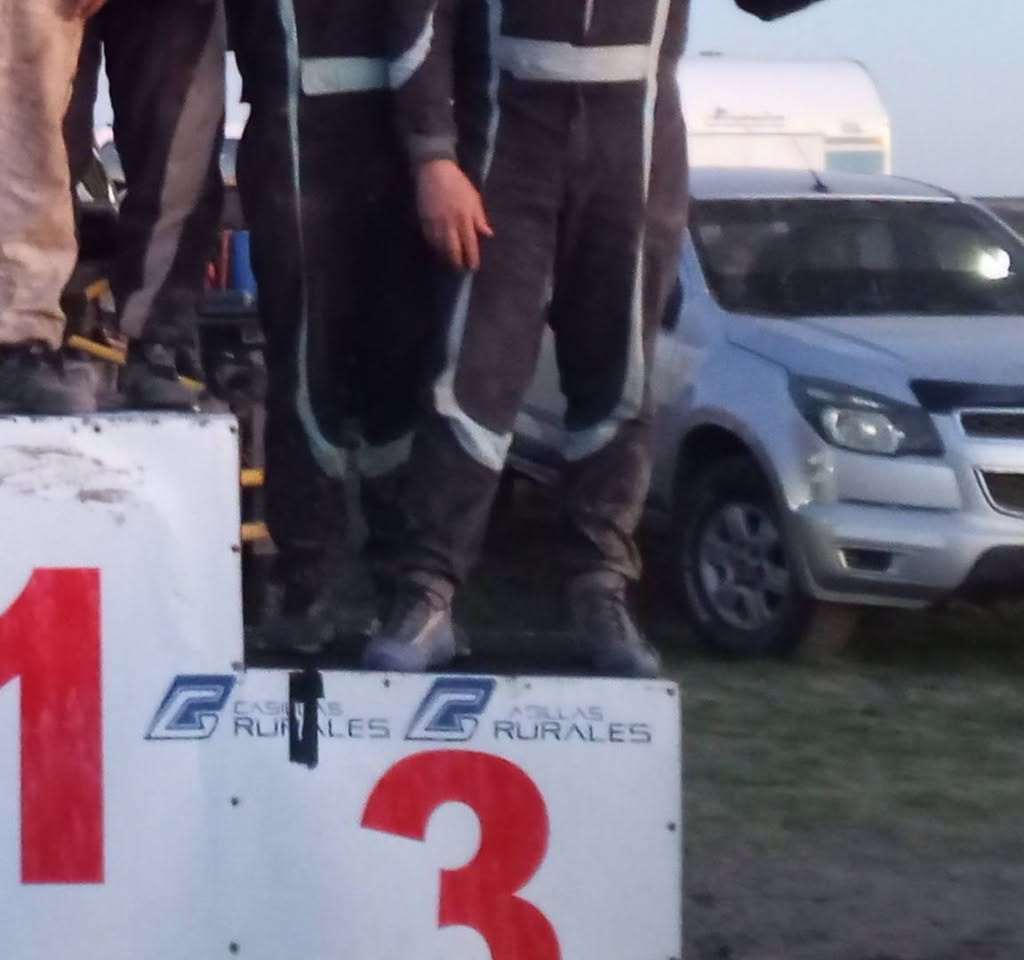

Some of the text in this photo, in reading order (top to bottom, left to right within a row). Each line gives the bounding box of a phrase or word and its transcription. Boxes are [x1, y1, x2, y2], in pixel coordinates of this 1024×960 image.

[233, 701, 343, 716] CASIAS
[493, 720, 653, 744] RURALES
[360, 748, 564, 960] 3
